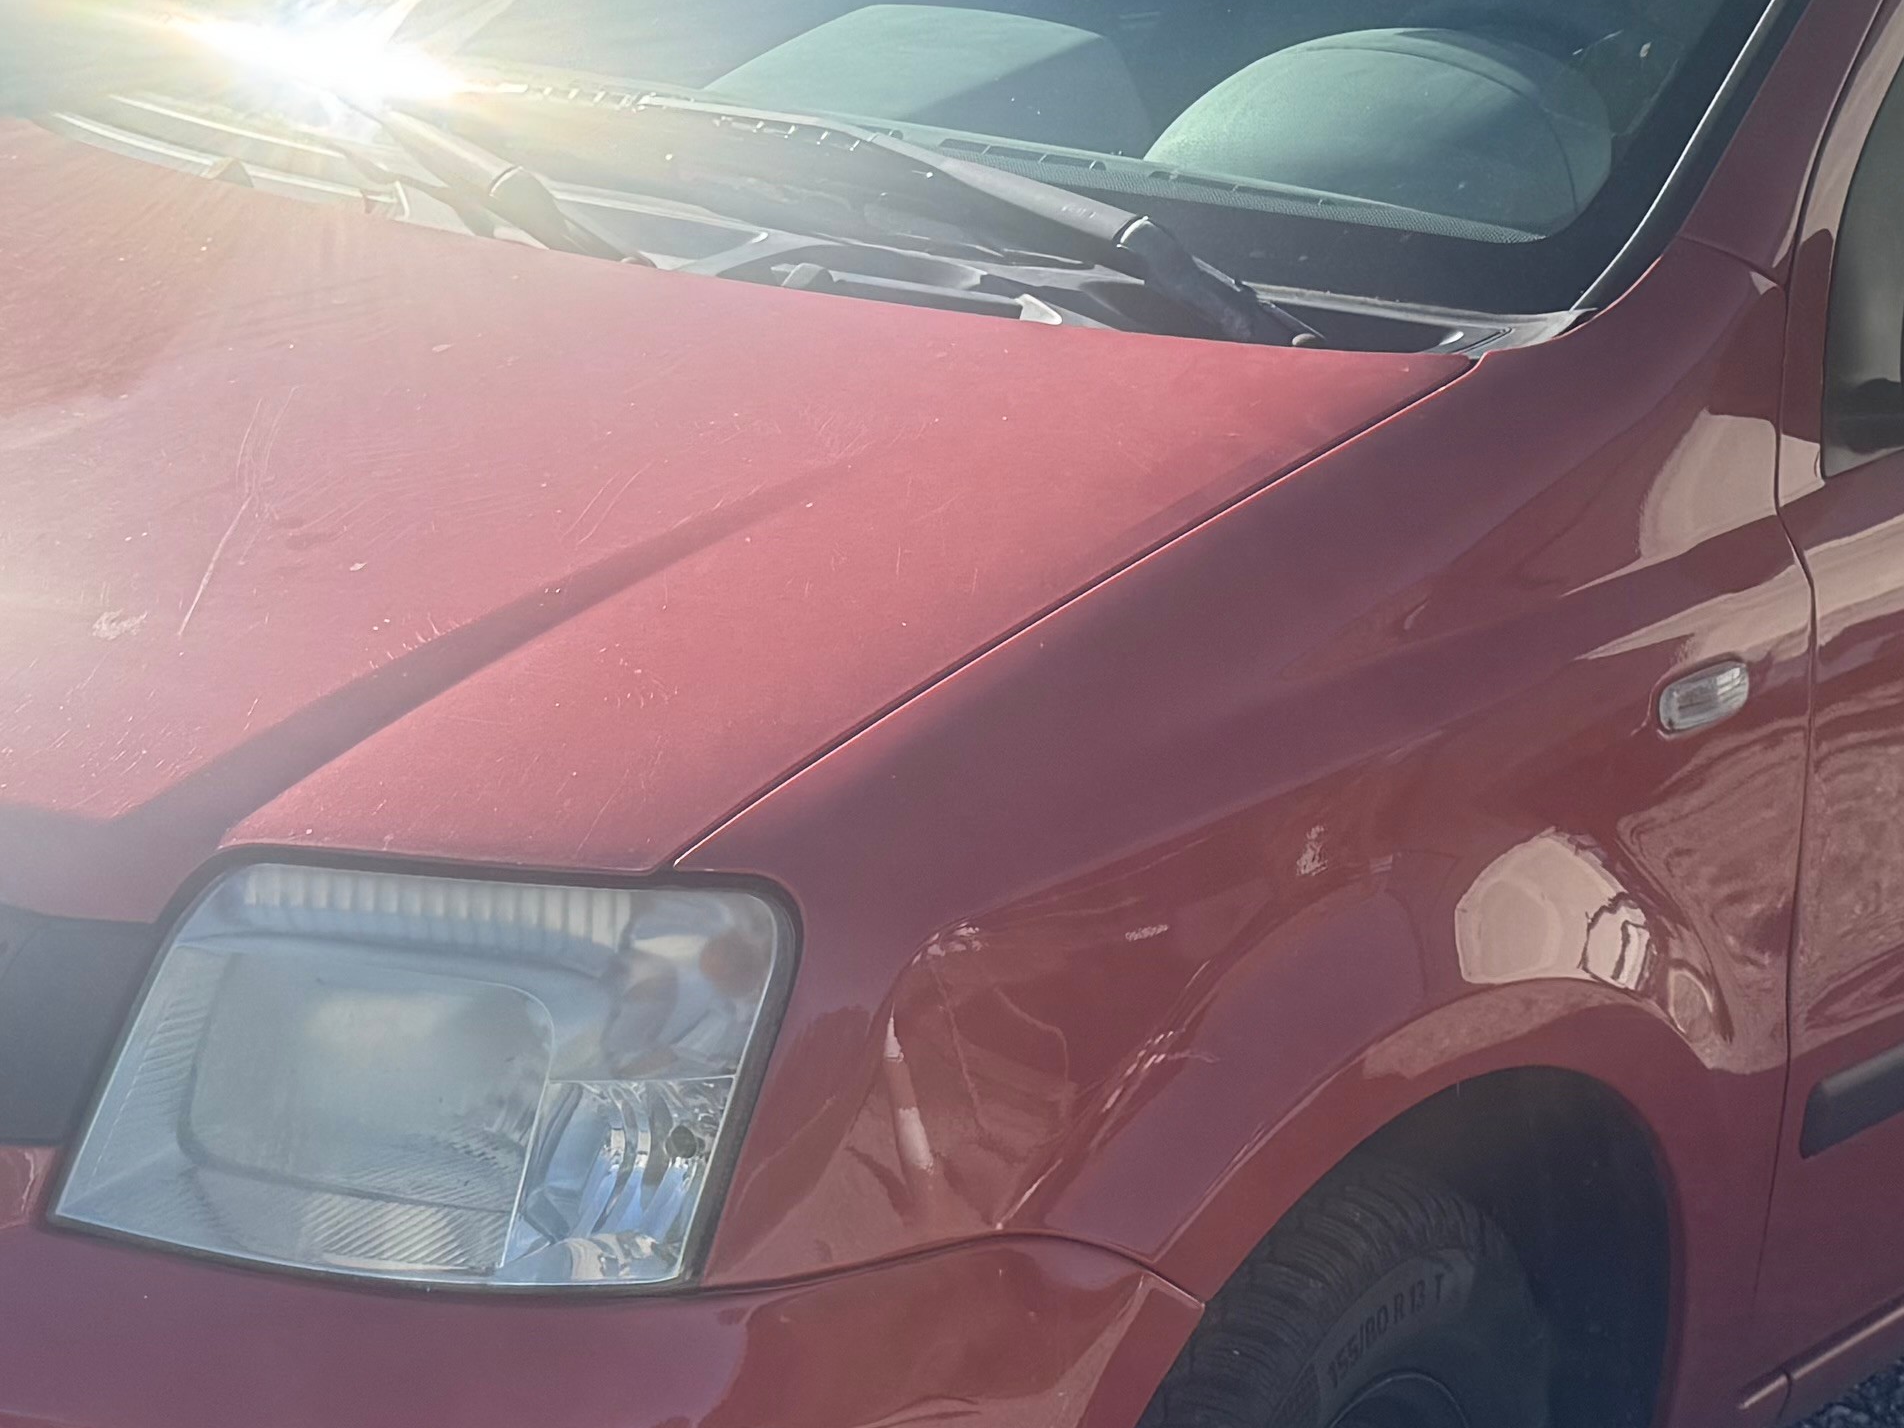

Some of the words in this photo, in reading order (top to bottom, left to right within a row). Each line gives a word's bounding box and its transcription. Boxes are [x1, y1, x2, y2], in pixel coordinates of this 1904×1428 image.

[1394, 1291, 1404, 1322] R
[1410, 1279, 1426, 1313] 13
[1434, 1273, 1444, 1303] T
